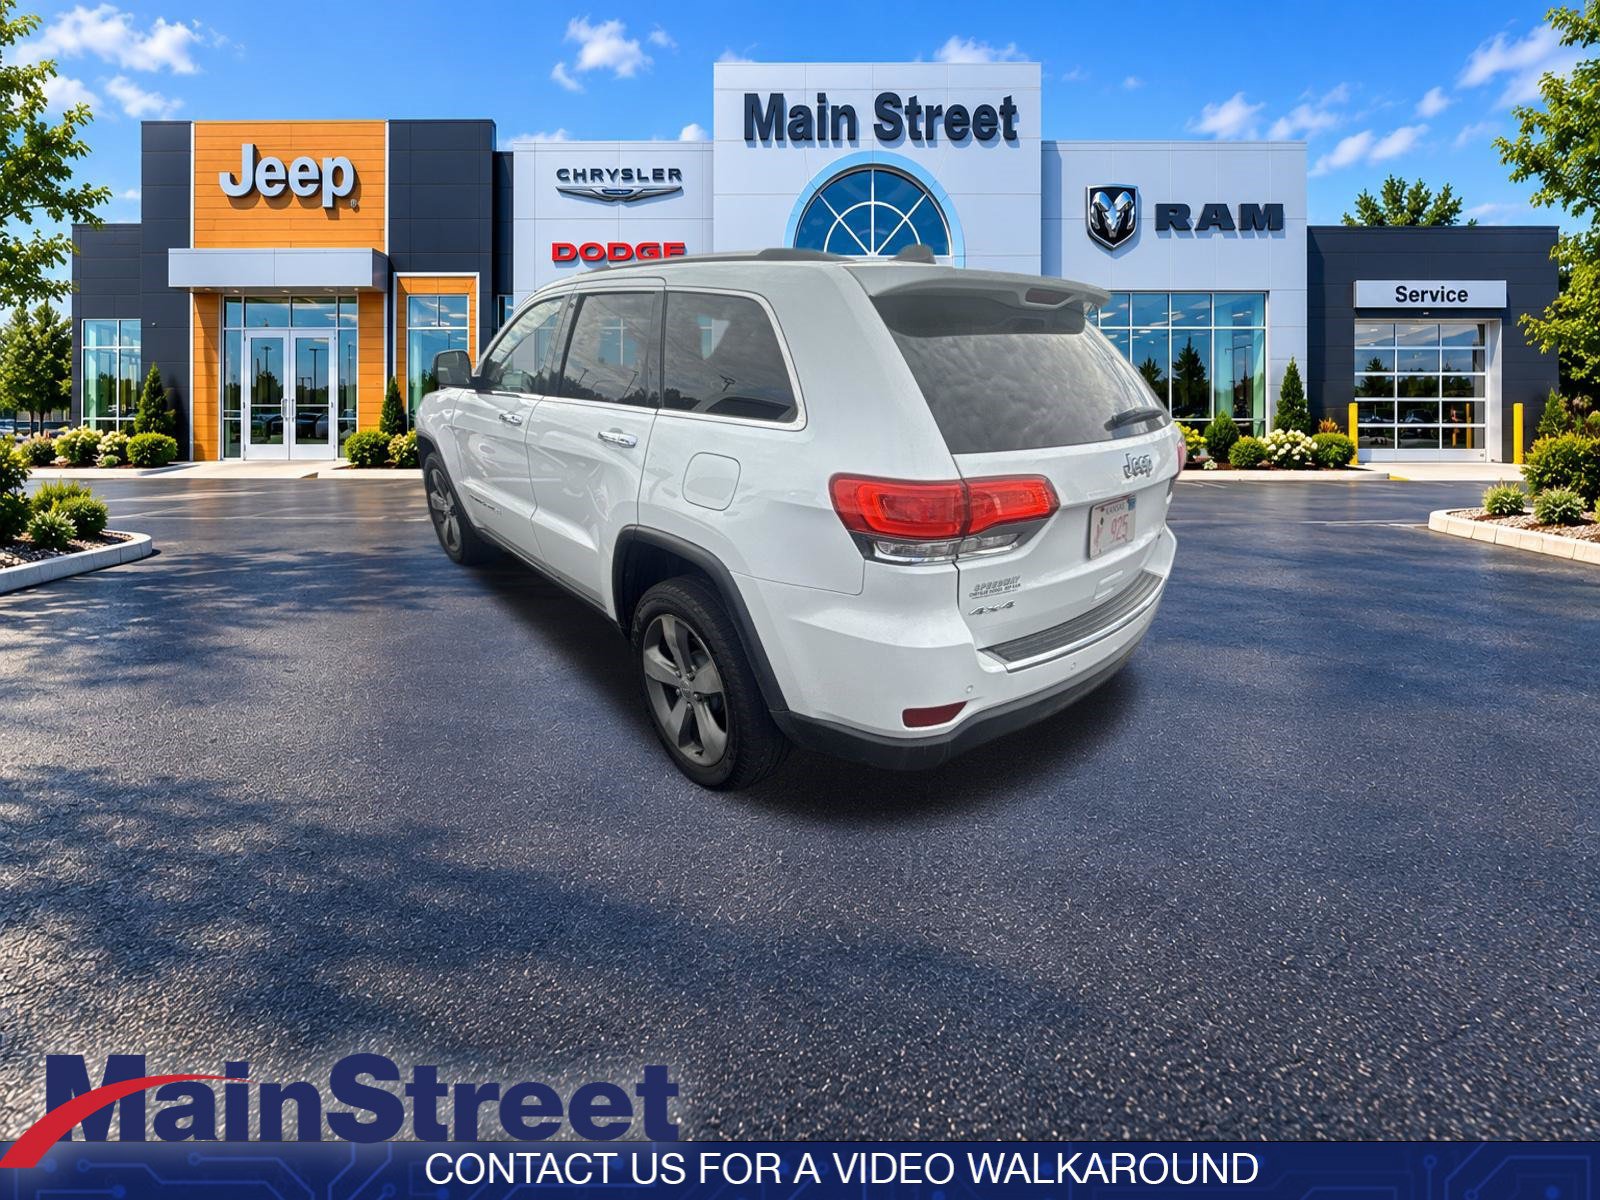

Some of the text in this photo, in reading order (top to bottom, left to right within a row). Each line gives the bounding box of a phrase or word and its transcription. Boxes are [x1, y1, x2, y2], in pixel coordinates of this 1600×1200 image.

[743, 91, 1018, 142] Main Street
[219, 143, 356, 208] Jeep
[556, 168, 683, 182] CHRYSLER
[1155, 203, 1284, 231] RAM
[551, 242, 686, 262] DODGE
[1395, 285, 1469, 303] Service
[1123, 453, 1153, 479] Jeep
[1105, 501, 1126, 515] KANSAS
[1111, 513, 1129, 541] 925
[974, 575, 1021, 592] SPEEDWAY
